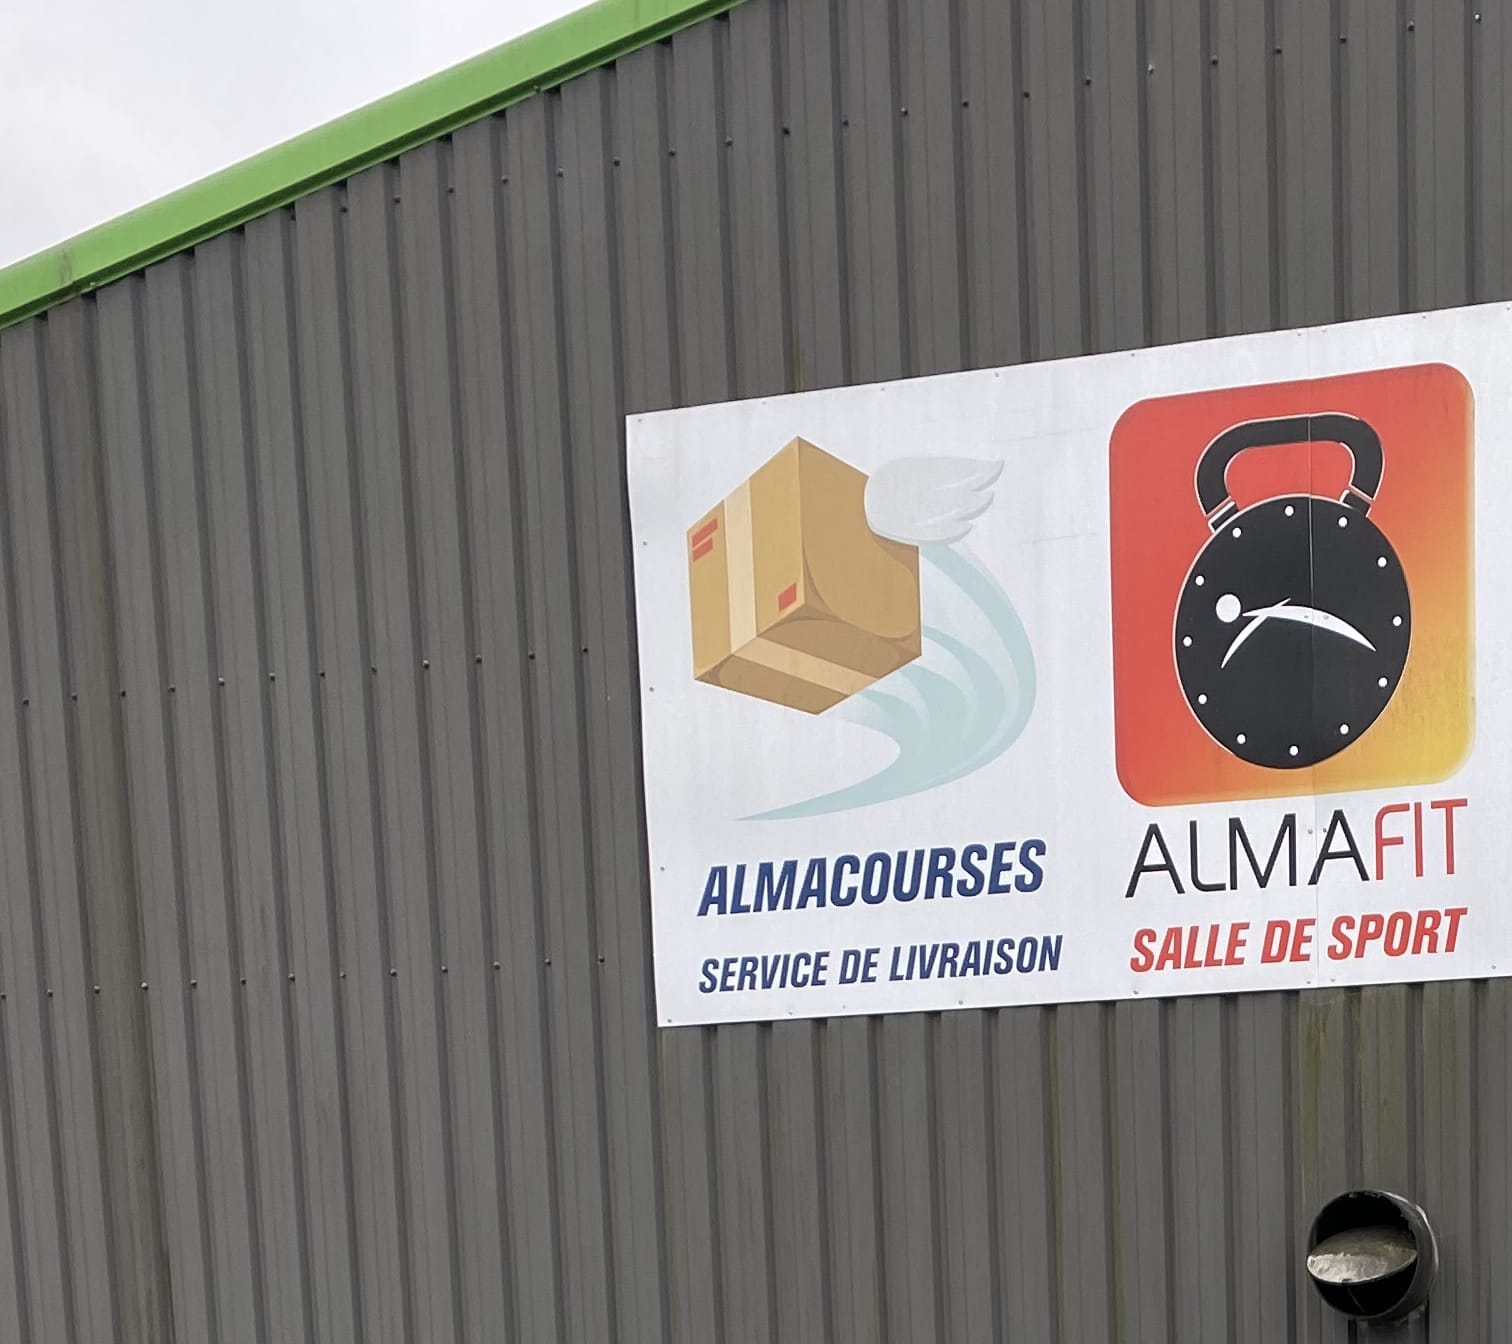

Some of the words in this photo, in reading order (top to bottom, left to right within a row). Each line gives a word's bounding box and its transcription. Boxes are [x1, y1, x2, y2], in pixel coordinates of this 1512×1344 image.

[696, 839, 1047, 917] ALMACOURSES
[1125, 798, 1468, 899] ALMAFIT
[699, 951, 830, 994] SERVICE
[838, 947, 881, 985] DE
[888, 934, 1063, 982] LIVRAISON
[1130, 922, 1250, 973] SALLE
[1260, 918, 1316, 964] DE
[1327, 907, 1468, 961] SPORT
